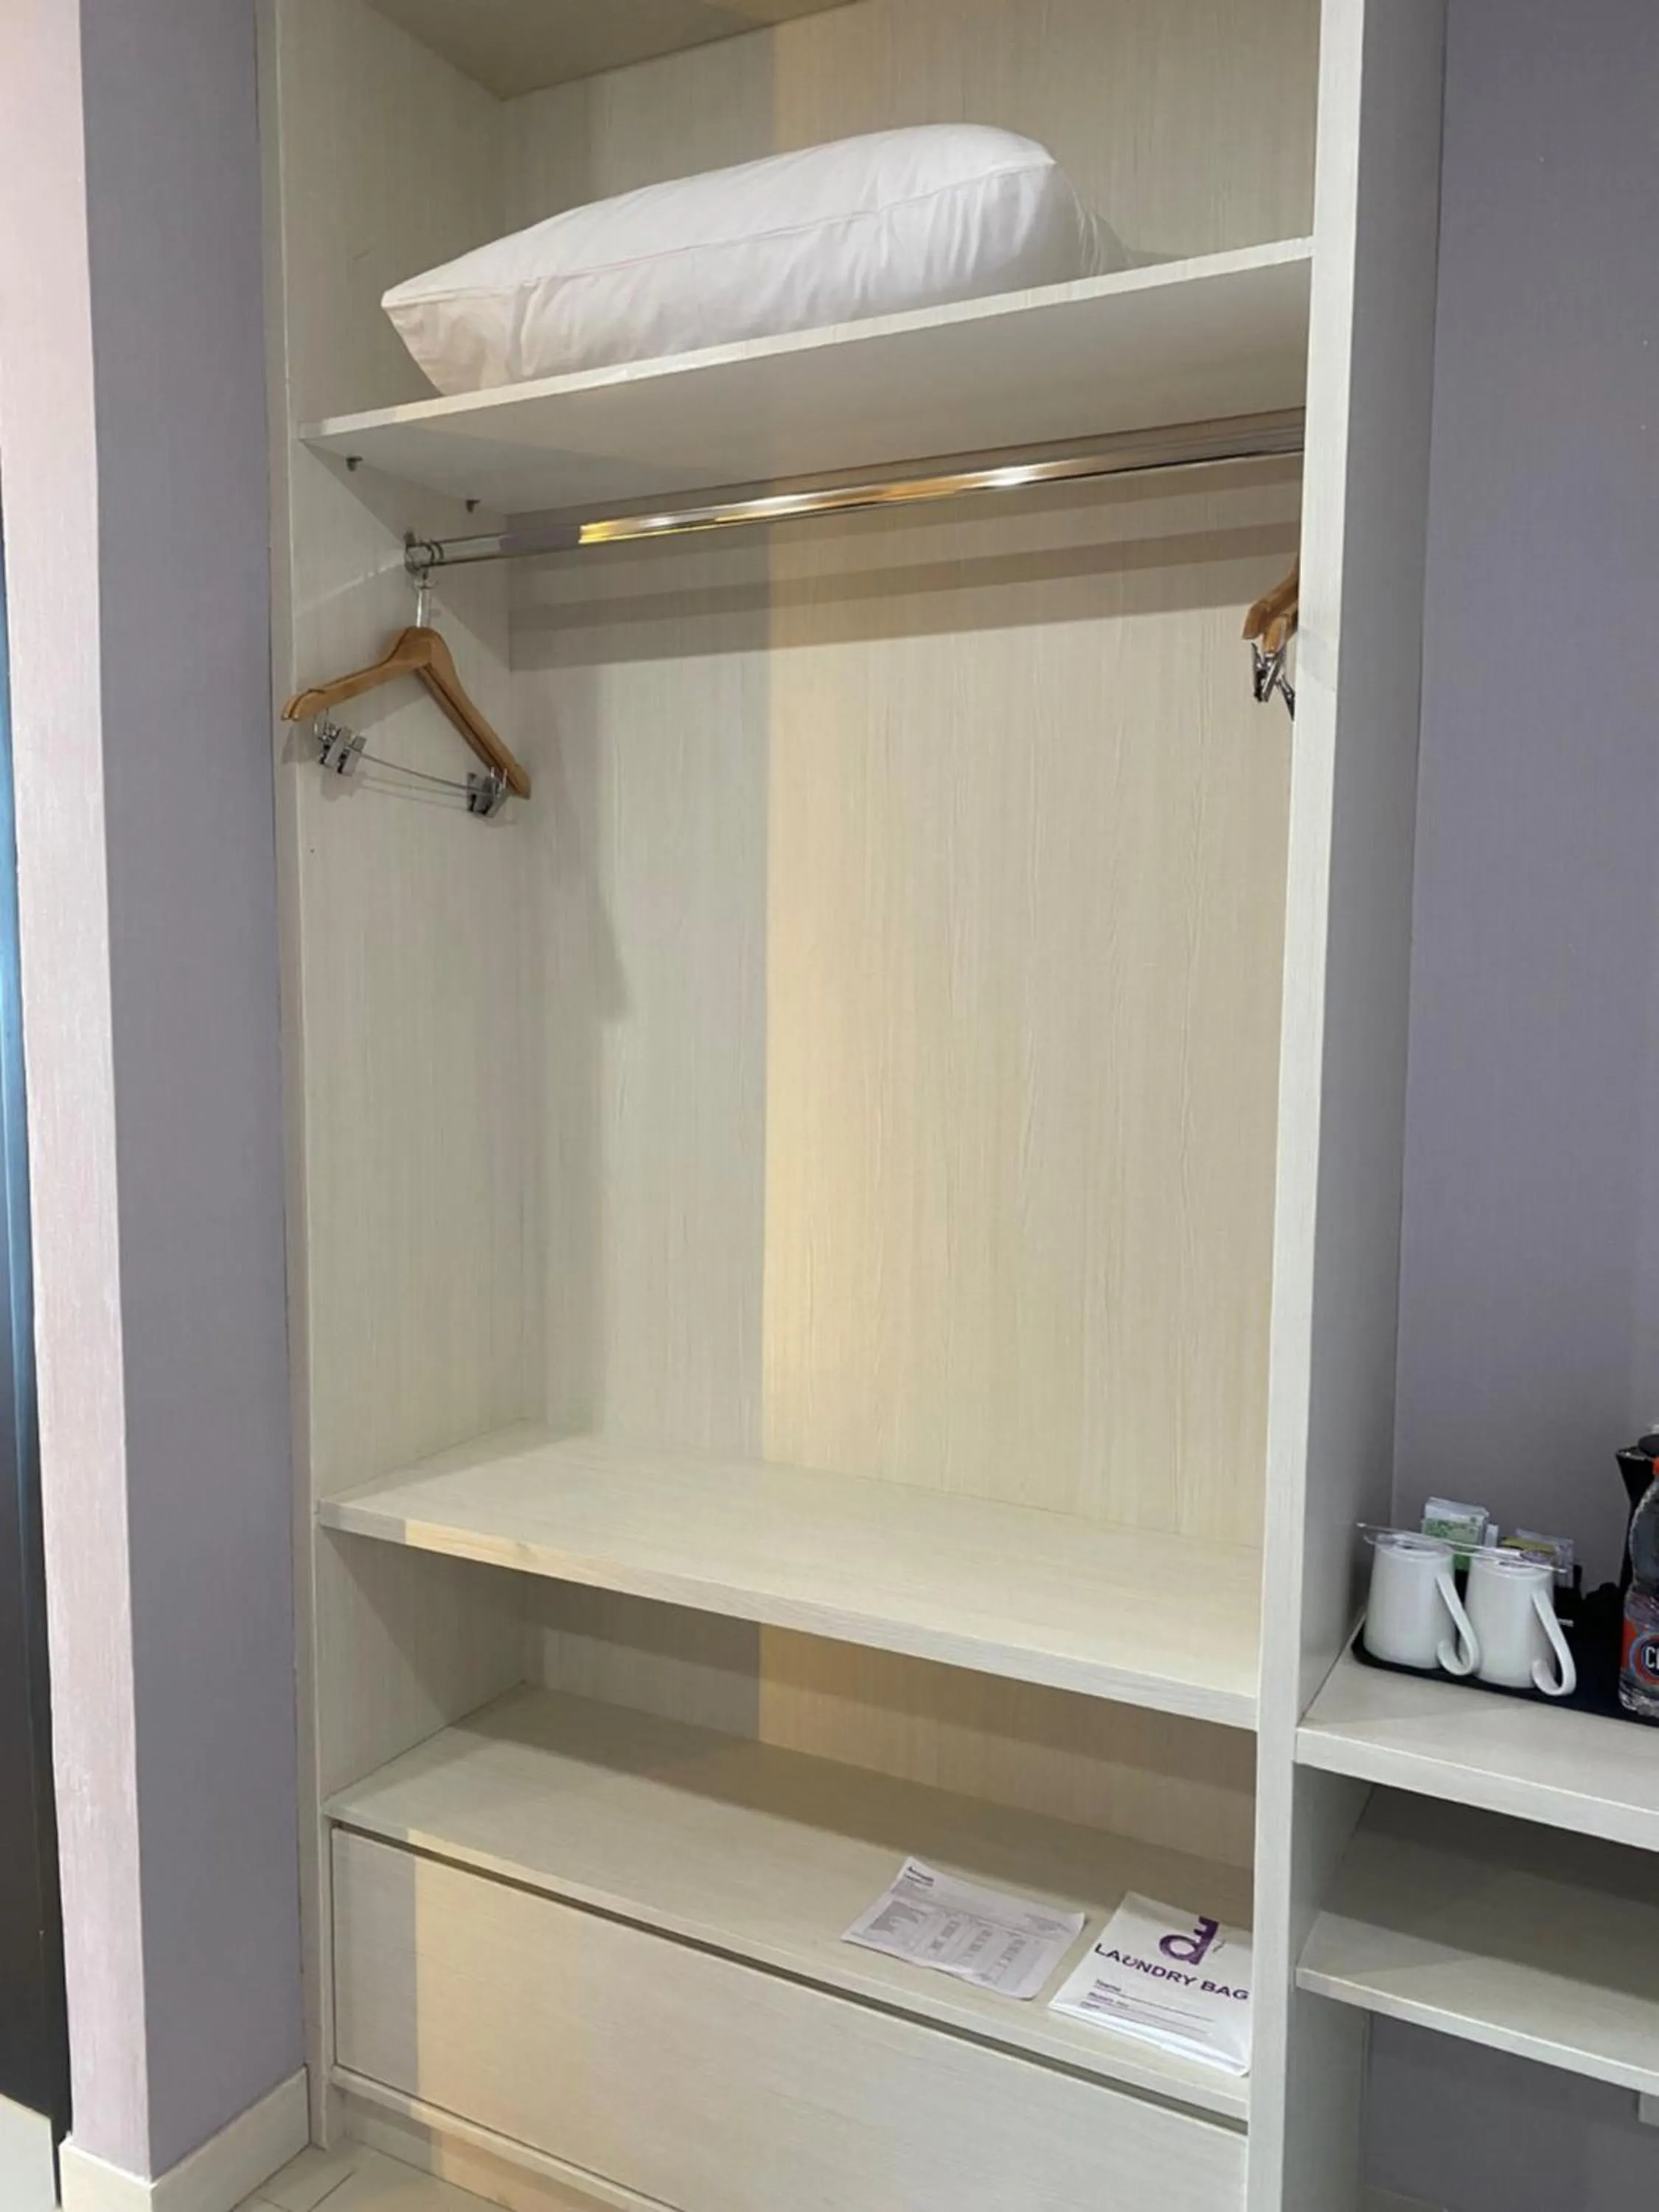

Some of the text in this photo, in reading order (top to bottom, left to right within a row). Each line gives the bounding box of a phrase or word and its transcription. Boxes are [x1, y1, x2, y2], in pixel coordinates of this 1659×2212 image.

[1646, 1646, 1659, 1669] C
[1095, 1943, 1249, 2000] LAUNDRY BAG
